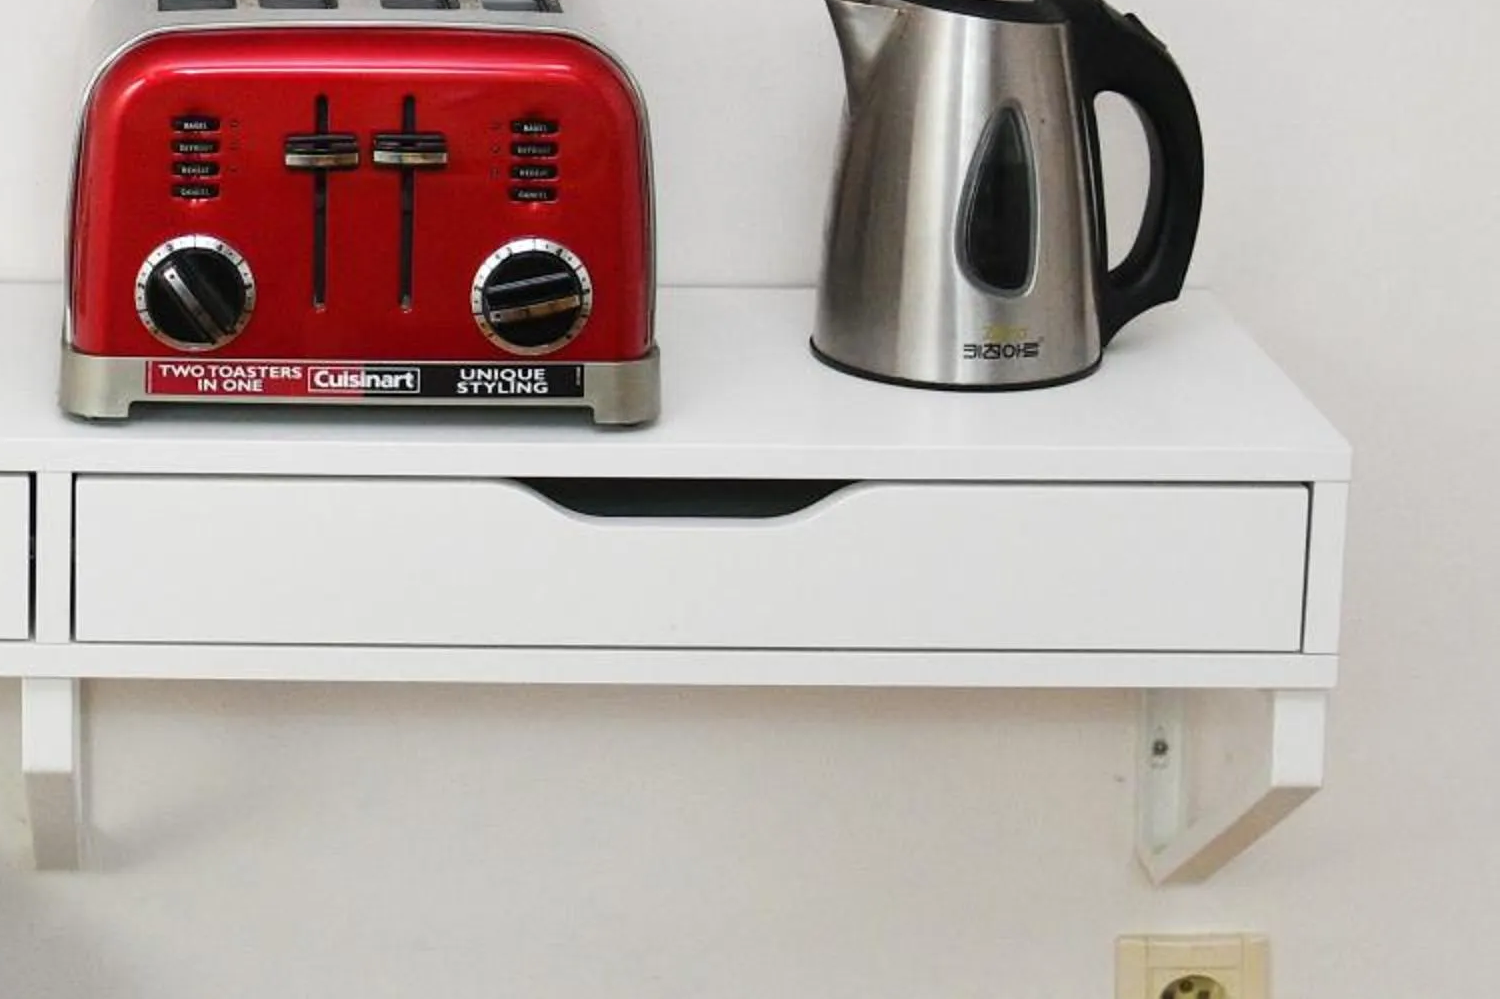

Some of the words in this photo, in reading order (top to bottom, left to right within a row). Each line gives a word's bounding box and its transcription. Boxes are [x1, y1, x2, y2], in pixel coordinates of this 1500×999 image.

[158, 364, 205, 378] TWO
[207, 365, 302, 379] TOASTERS
[459, 368, 546, 382] UNIQUE
[197, 378, 218, 392] IN
[222, 378, 264, 392] ONE
[313, 369, 415, 389] Cuisinart
[456, 380, 549, 394] STYLING
